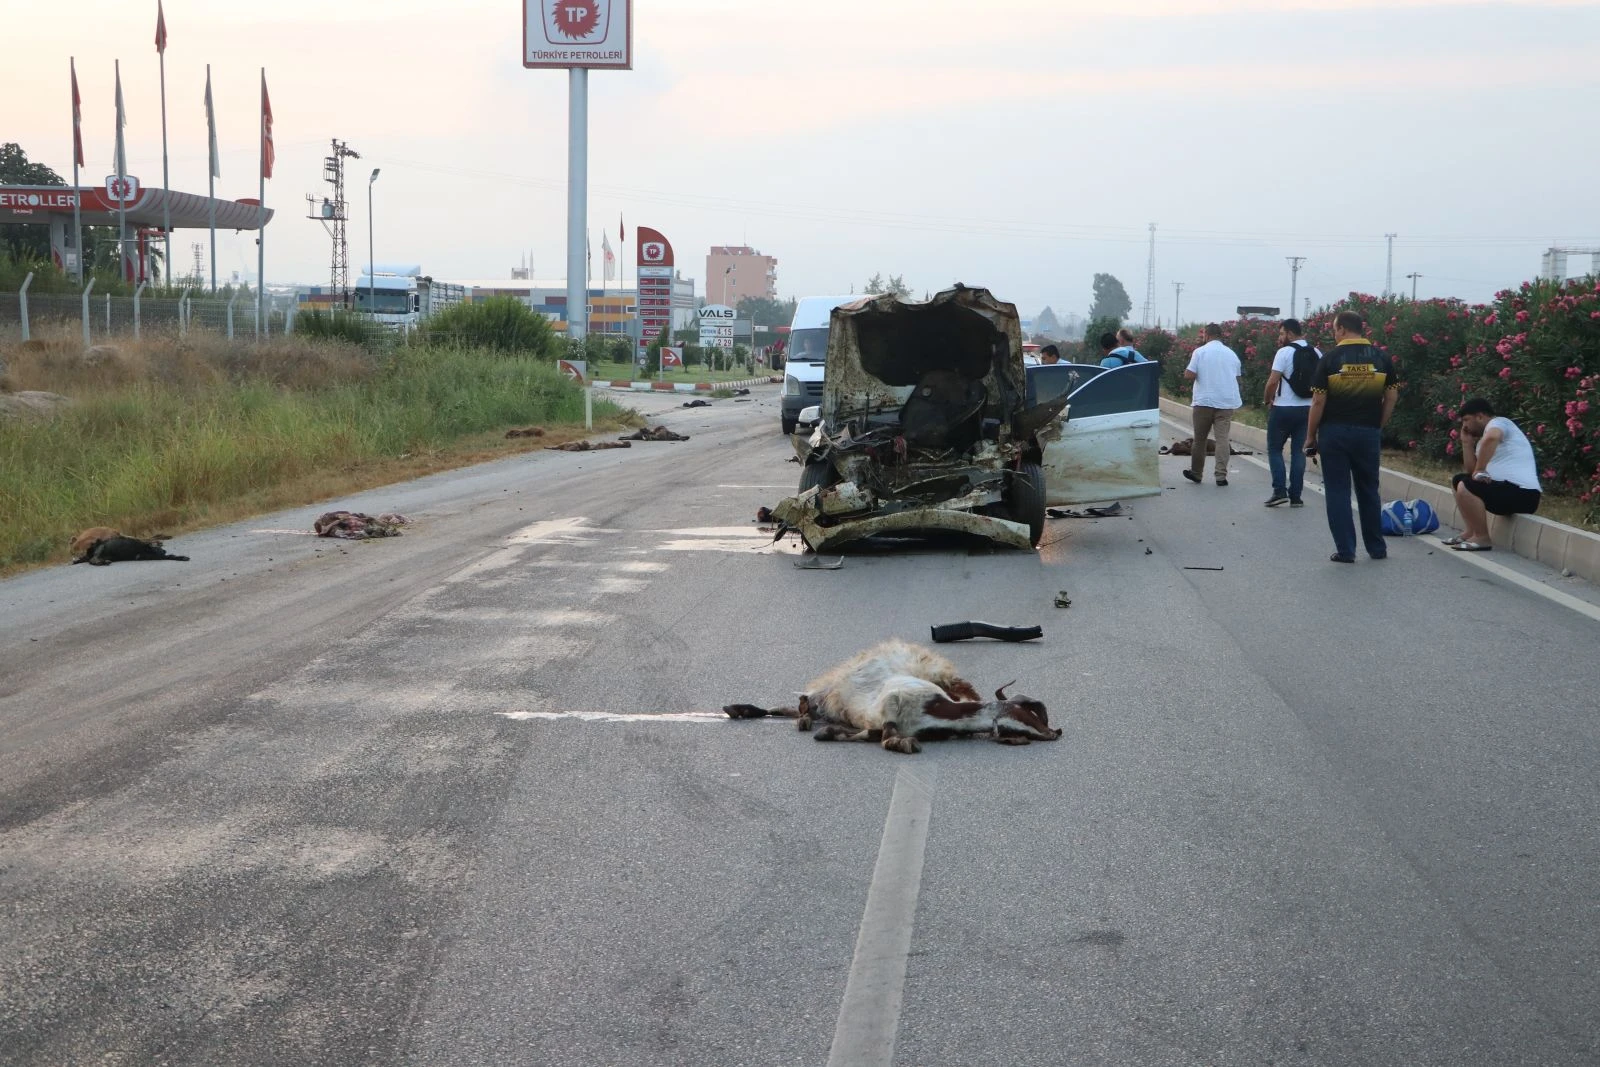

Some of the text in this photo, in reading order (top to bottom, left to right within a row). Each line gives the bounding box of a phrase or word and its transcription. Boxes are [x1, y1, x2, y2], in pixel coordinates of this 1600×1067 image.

[565, 7, 587, 22] TP
[532, 50, 622, 59] TÜRKİYE PETROLLERİ
